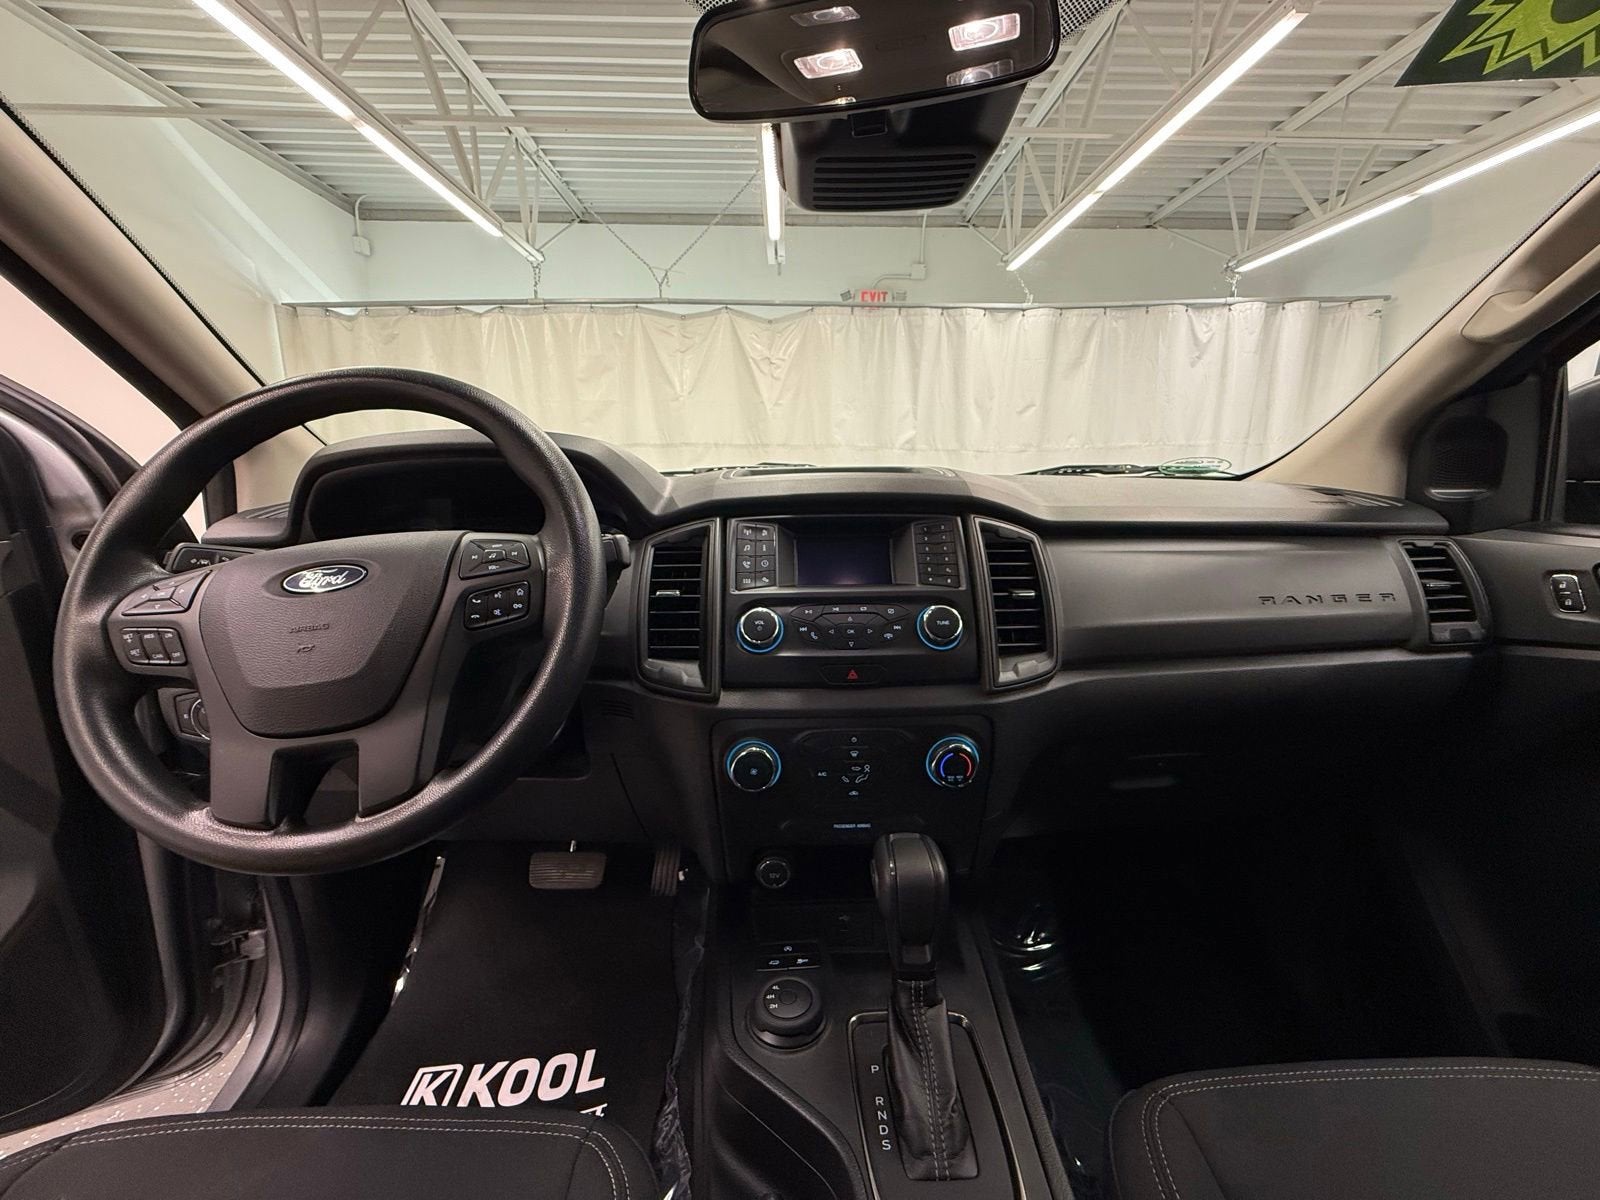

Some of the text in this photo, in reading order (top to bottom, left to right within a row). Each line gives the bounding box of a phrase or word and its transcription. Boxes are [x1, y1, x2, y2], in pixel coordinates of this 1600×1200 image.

[298, 567, 348, 588] Ford
[1258, 592, 1397, 605] RANGER
[289, 623, 330, 634] AIRBAG
[871, 1065, 880, 1074] P
[457, 1049, 606, 1108] KOOL
[875, 1096, 884, 1106] R
[877, 1110, 887, 1120] N
[879, 1125, 889, 1135] D
[882, 1139, 892, 1151] S
